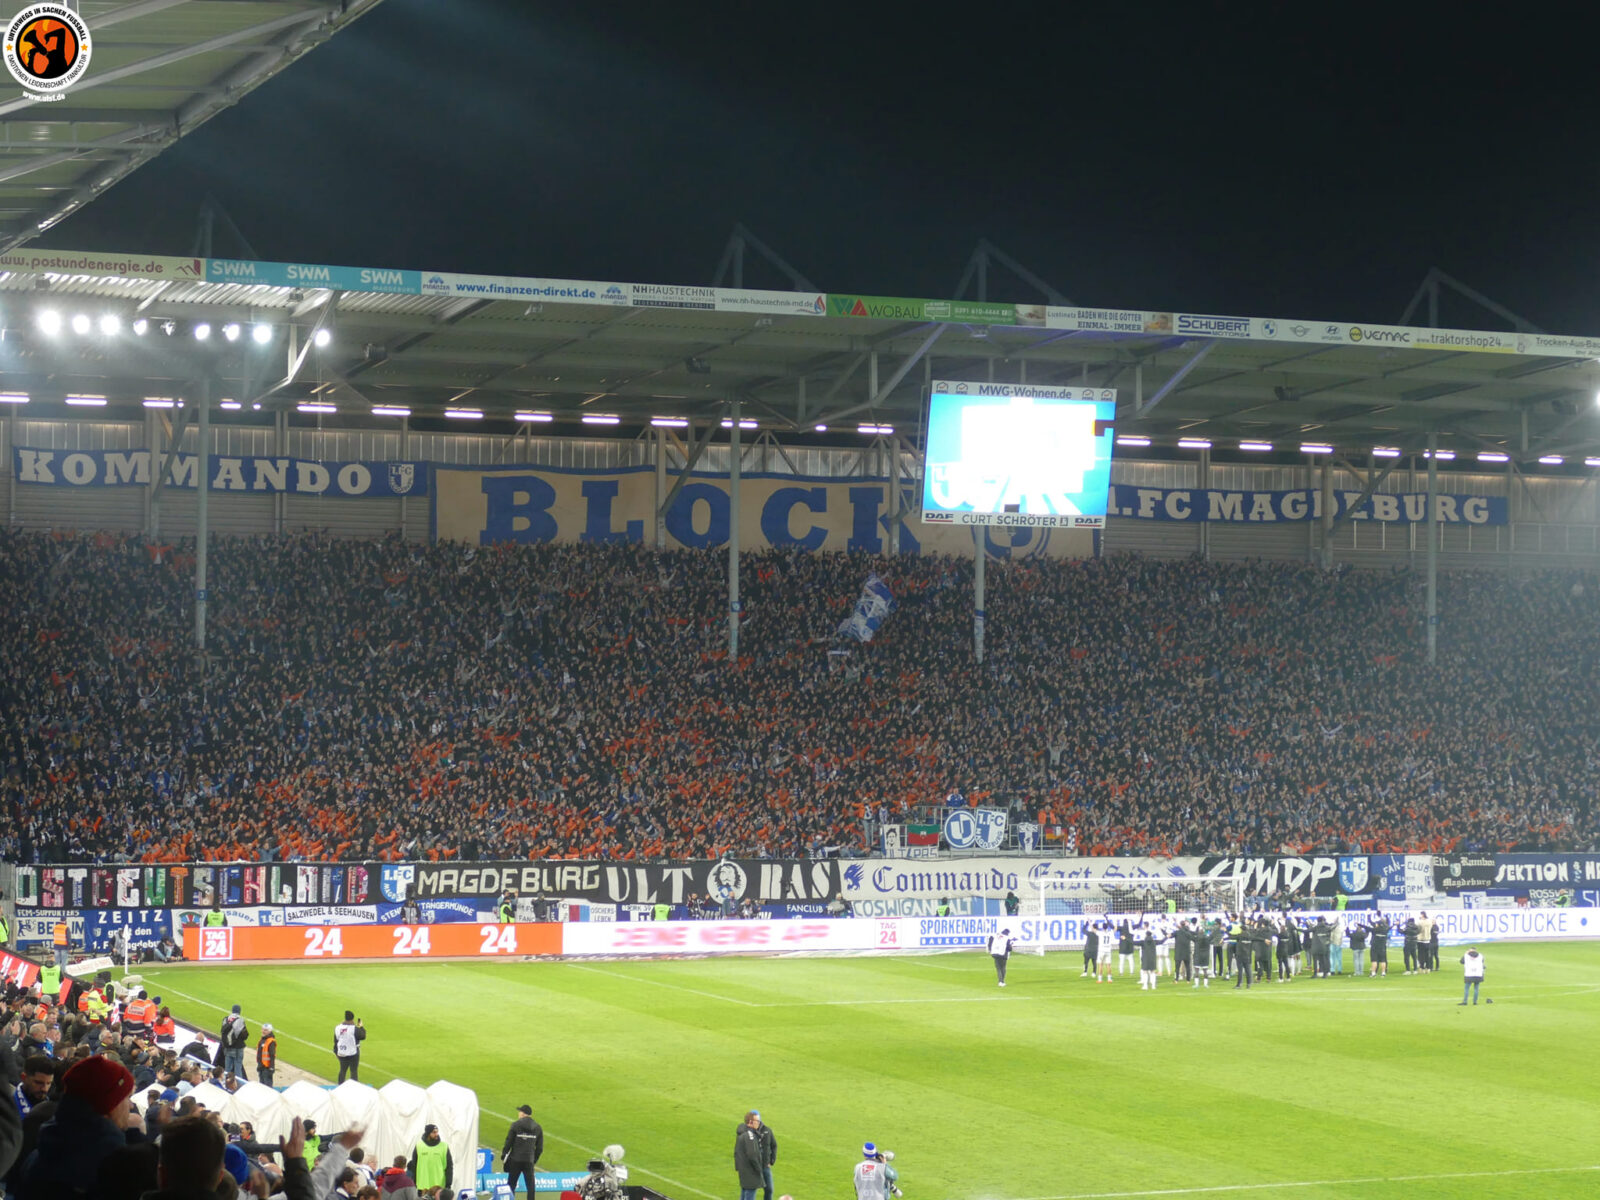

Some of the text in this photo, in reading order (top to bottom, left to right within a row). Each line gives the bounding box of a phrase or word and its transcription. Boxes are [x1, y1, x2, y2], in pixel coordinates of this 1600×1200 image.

[212, 261, 256, 276] SWM
[287, 266, 330, 281] SWM
[360, 270, 403, 284] SWM
[456, 283, 596, 298] www.finanzen-direkt.de
[869, 304, 920, 319] WOBAU
[978, 385, 1072, 399] MWG-Wohnen.de
[19, 448, 372, 496] KOMMANDO
[479, 474, 921, 555] BLOCK
[962, 513, 1056, 526] CURT SCHRÖTER
[872, 866, 1018, 894] Commando
[1028, 862, 1092, 891] East
[1495, 862, 1569, 882] SEKTION
[418, 865, 600, 895] MAGDEBURG
[1442, 877, 1492, 888] Magdeburg
[1390, 886, 1423, 895] REFORM
[787, 905, 823, 913] FANCLUB
[913, 896, 972, 916] ANALT
[98, 910, 163, 924] ZEITZ
[287, 908, 325, 921] SALZWEDEL
[335, 907, 375, 921] SEEHAUSEN
[380, 907, 402, 922] STEN
[38, 922, 84, 934] BEIN
[920, 918, 997, 935] SPORKENBACH
[1436, 911, 1568, 934] GRUNDSTÜCKE
[135, 927, 152, 936] den
[205, 931, 225, 939] TAG
[480, 925, 517, 953] 24
[880, 931, 897, 944] 24
[304, 928, 342, 956] 24
[393, 926, 431, 954] 24
[205, 940, 227, 956] 24
